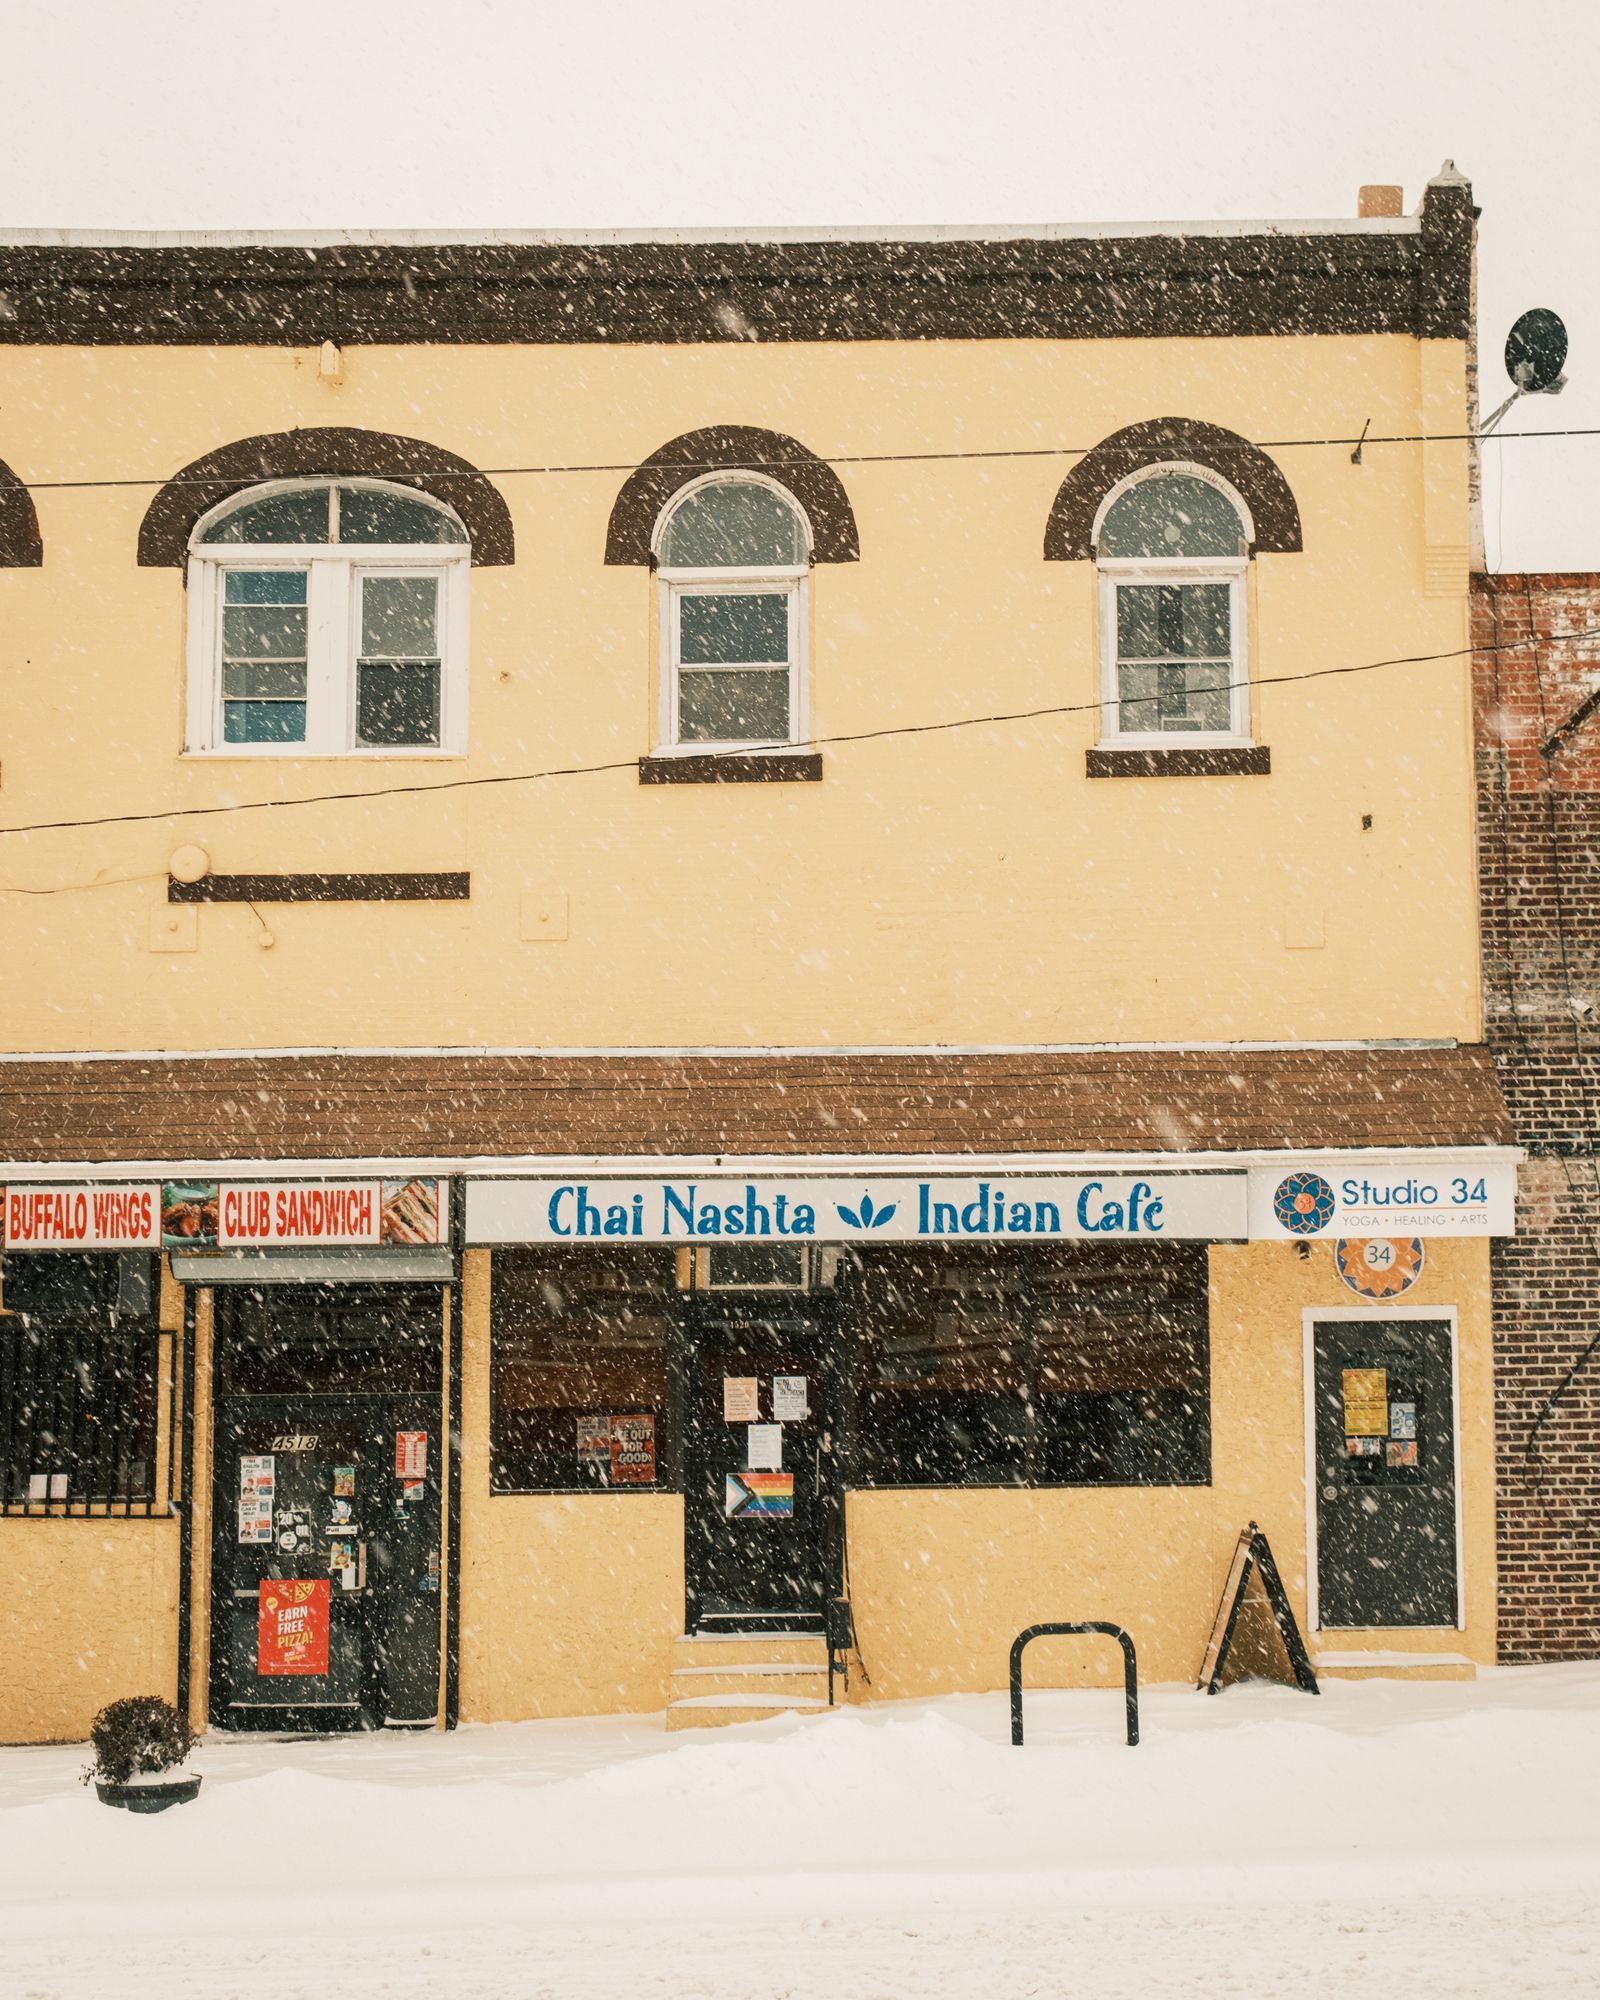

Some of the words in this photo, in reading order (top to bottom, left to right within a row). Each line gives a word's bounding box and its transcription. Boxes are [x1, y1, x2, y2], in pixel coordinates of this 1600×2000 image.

[1342, 1179, 1438, 1206] Studio
[1451, 1178, 1488, 1204] 34
[10, 1192, 88, 1240] BUFFALO
[93, 1192, 152, 1240] WINGS
[225, 1190, 271, 1238] CLUB
[275, 1189, 372, 1237] SANDWICH
[548, 1186, 643, 1235] Chai
[661, 1185, 816, 1235] Nashta
[918, 1183, 1061, 1234] Indian
[1077, 1182, 1165, 1232] Café
[1342, 1215, 1380, 1226] YOGA
[1394, 1214, 1446, 1225] HEALING
[1460, 1214, 1488, 1225] ARTS
[1367, 1245, 1391, 1264] 34
[274, 1436, 316, 1450] 4518
[618, 1452, 650, 1464] GOOD
[277, 1605, 308, 1622] EARN
[277, 1620, 304, 1635] FREE
[277, 1631, 314, 1649] PIZZA!
